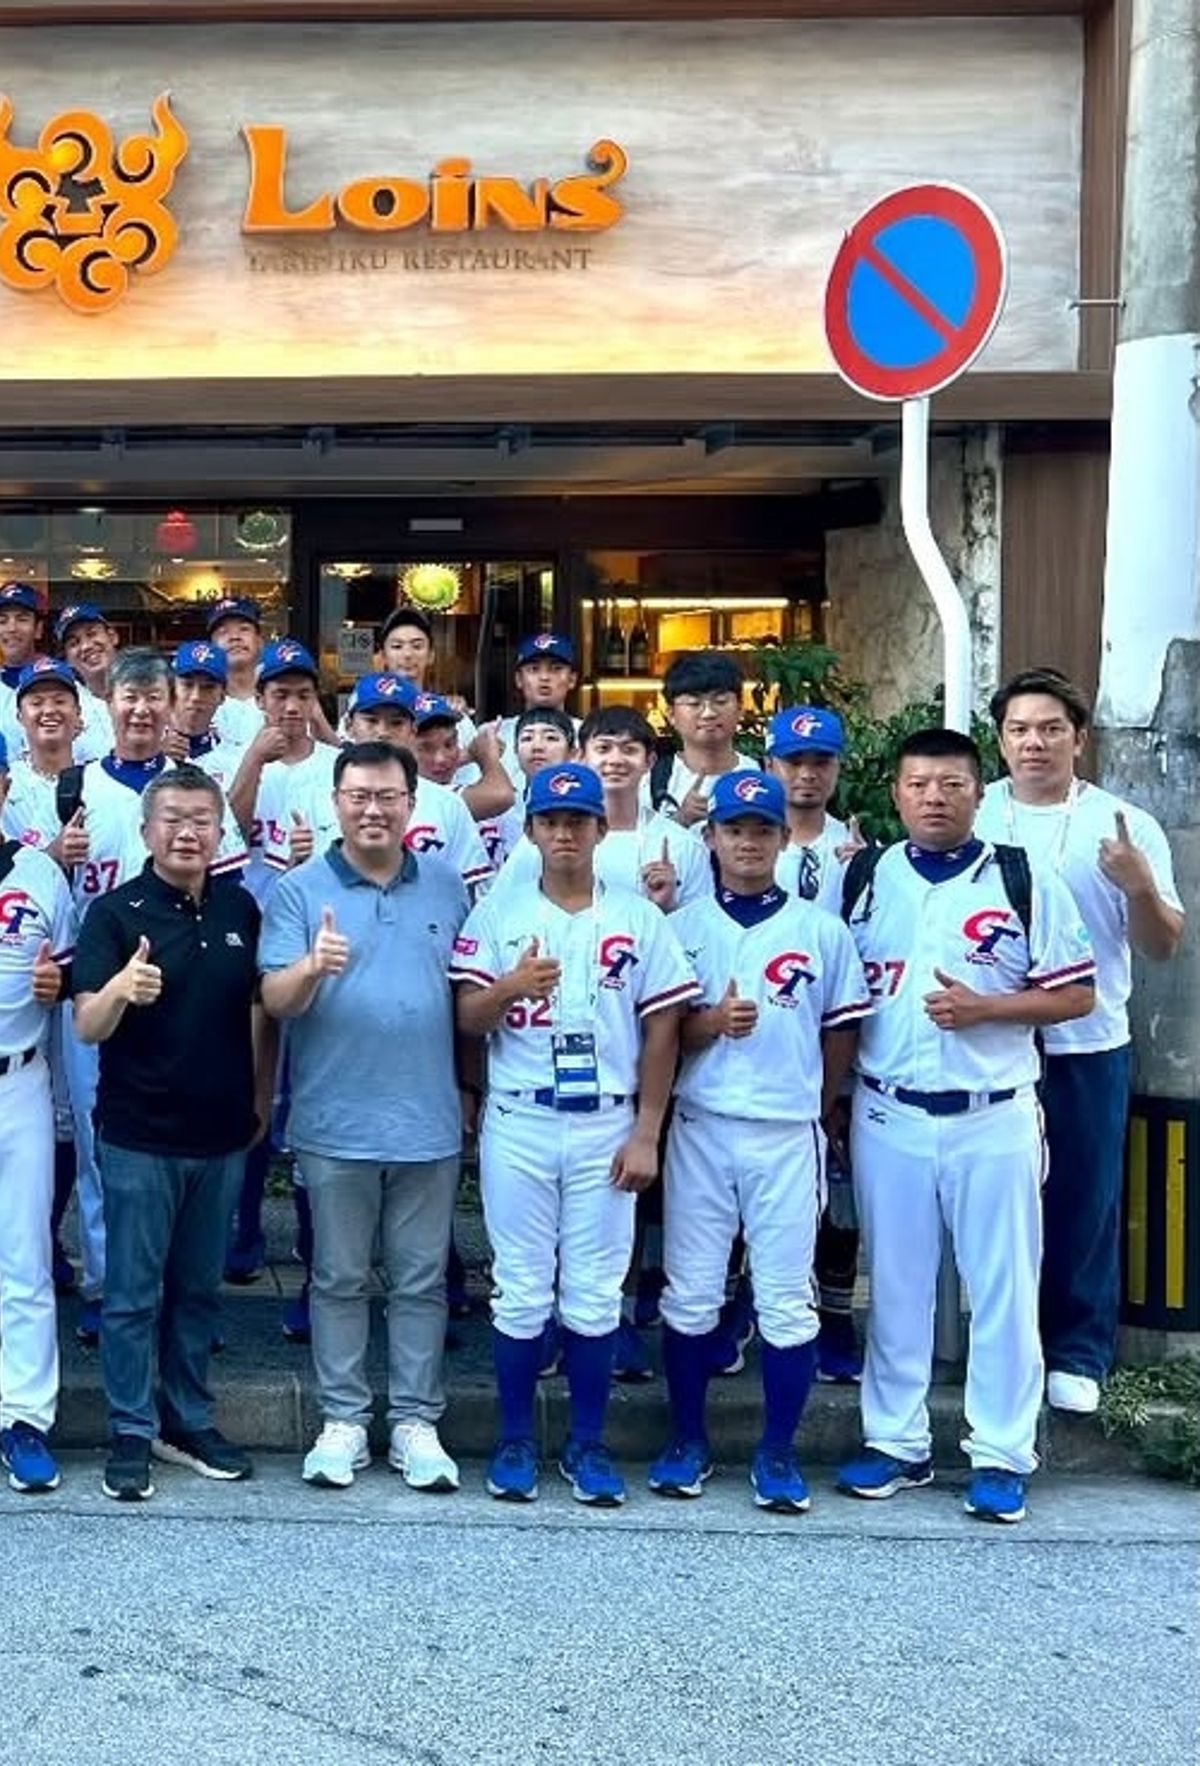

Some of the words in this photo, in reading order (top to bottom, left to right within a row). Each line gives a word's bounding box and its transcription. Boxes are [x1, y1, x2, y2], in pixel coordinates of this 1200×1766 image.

[402, 248, 592, 271] RESTAURANT
[82, 859, 119, 894] 37
[864, 959, 906, 997] 27
